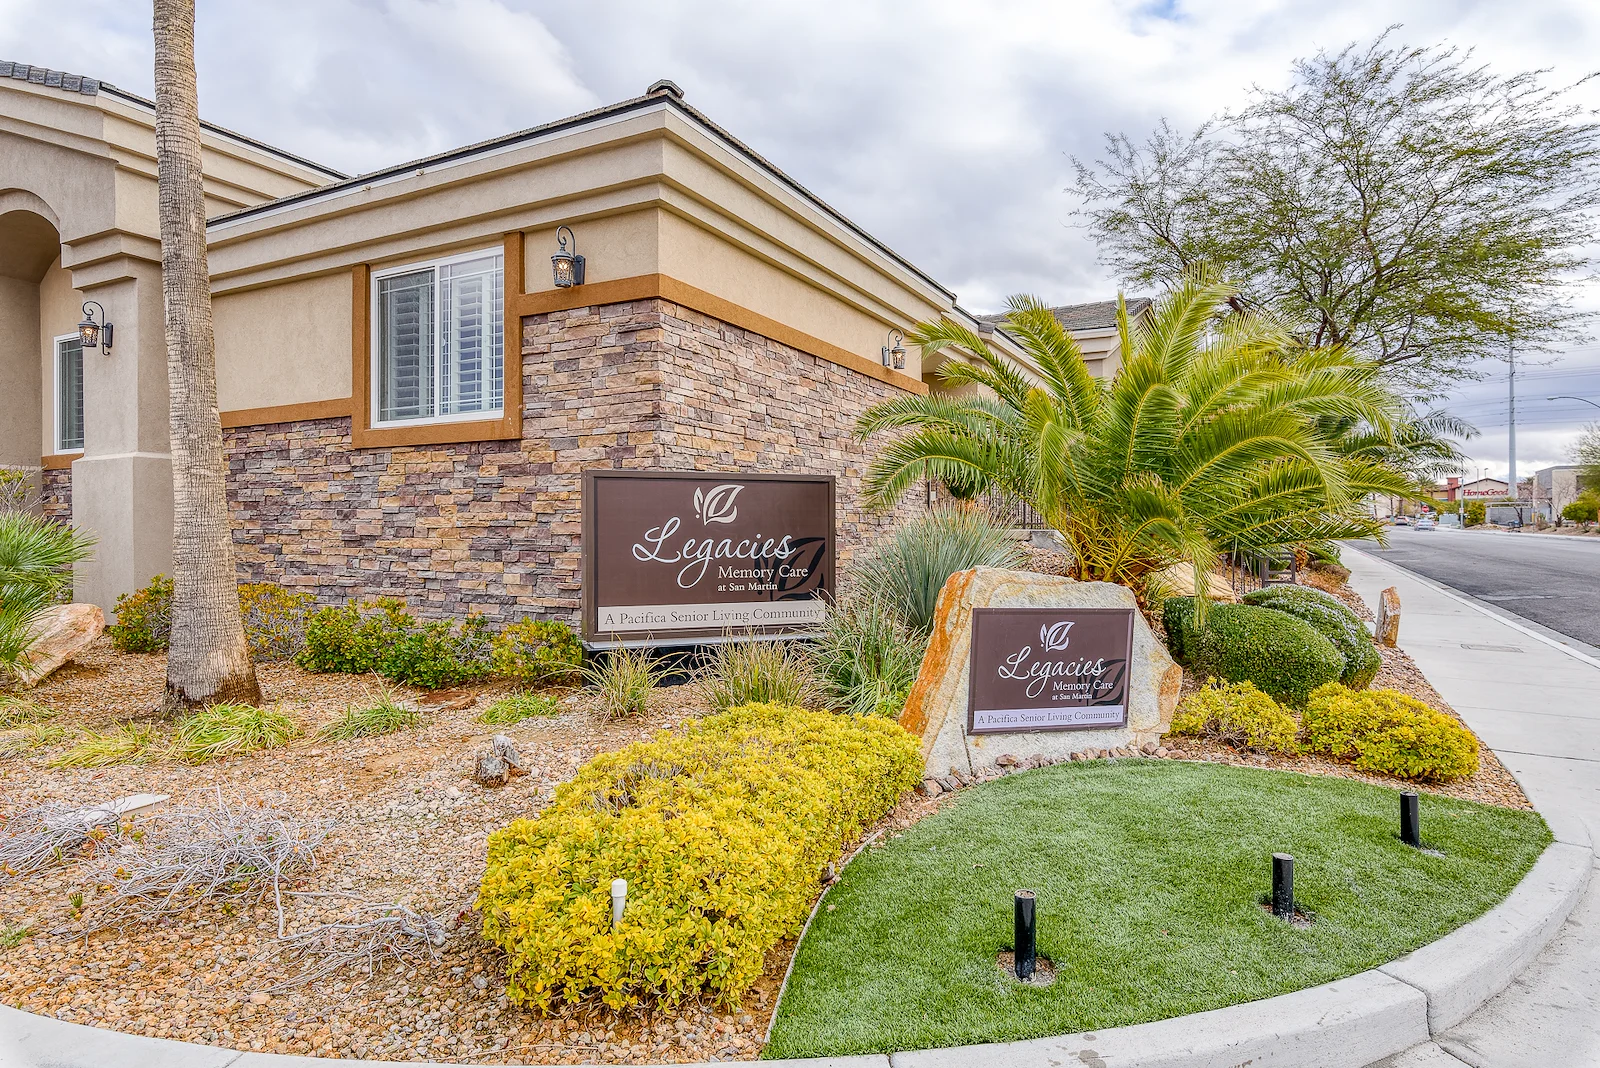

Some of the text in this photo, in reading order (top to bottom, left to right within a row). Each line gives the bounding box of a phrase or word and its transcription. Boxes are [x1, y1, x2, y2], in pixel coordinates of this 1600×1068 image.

[632, 516, 797, 589] Legacies
[717, 564, 809, 582] Memory Care
[717, 581, 778, 592] at San Martin
[604, 607, 821, 625] A Pacifica Senior Living Community
[997, 645, 1107, 699] Legacies
[1052, 680, 1114, 693] Memory Care
[1071, 692, 1093, 700] Martin
[978, 710, 1120, 724] A Pacifica Senior Living Community
